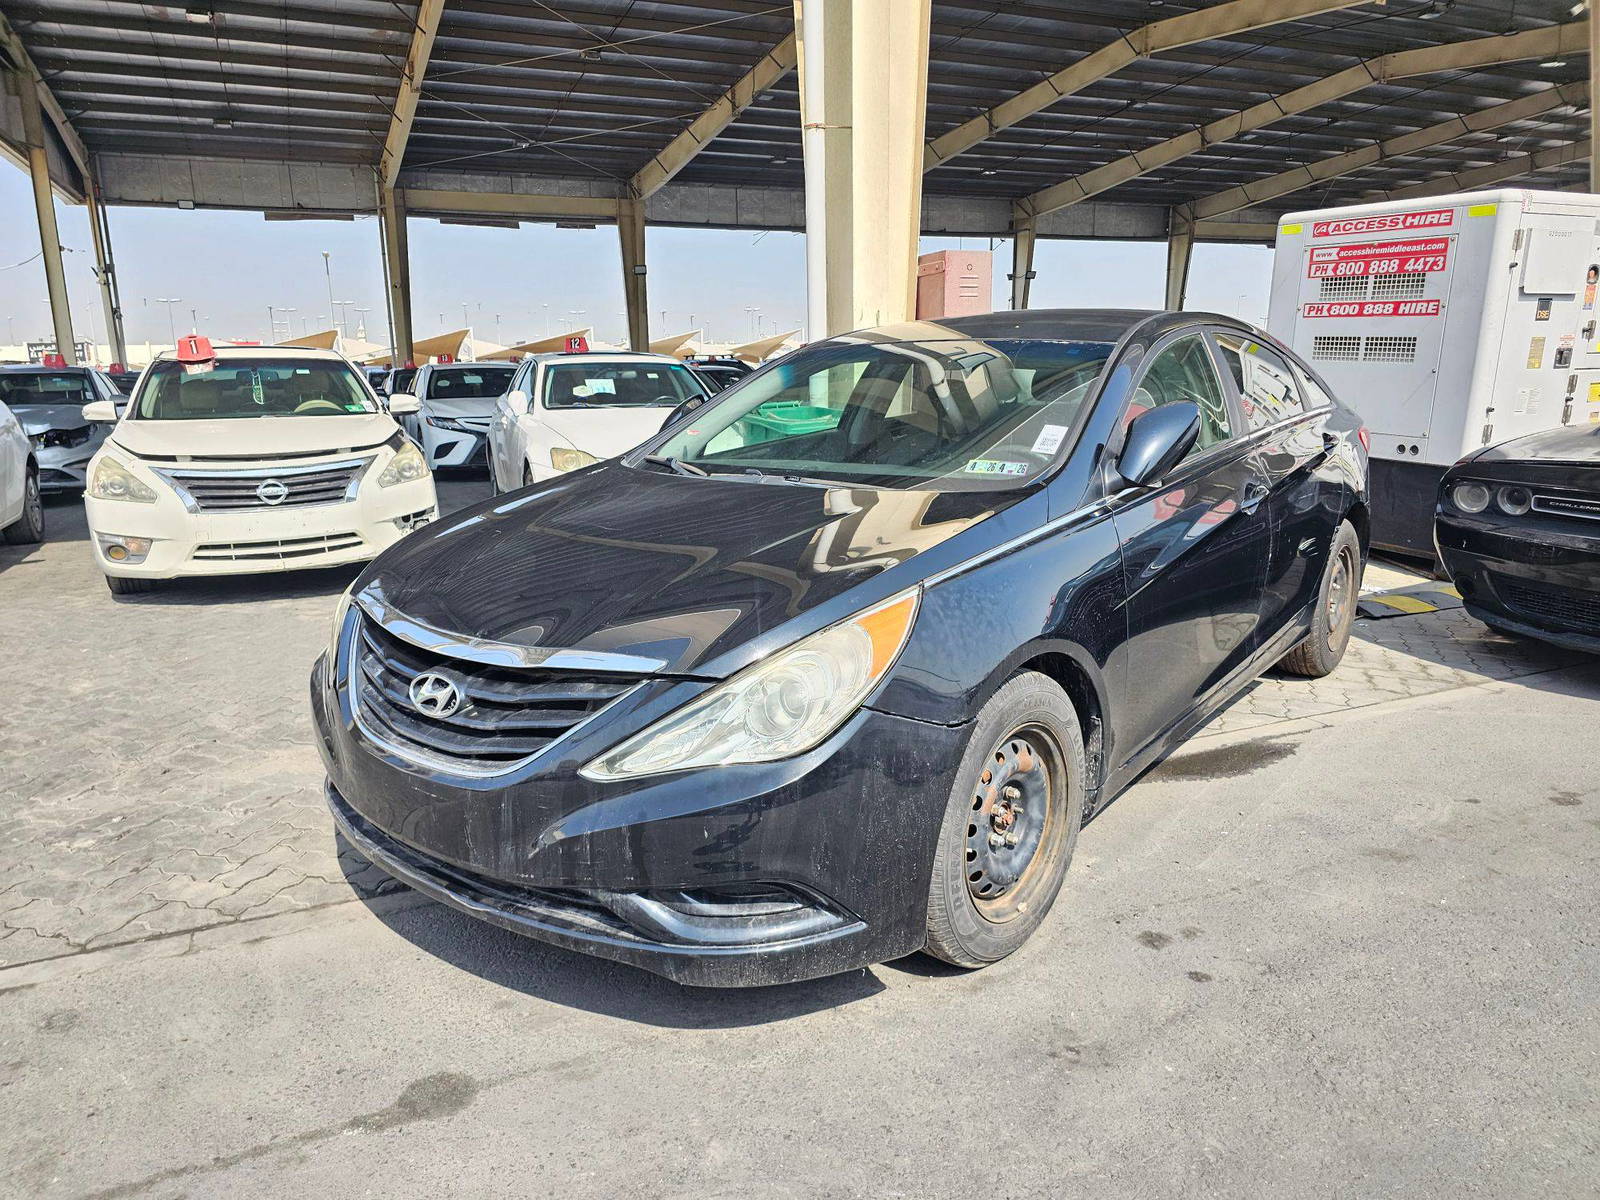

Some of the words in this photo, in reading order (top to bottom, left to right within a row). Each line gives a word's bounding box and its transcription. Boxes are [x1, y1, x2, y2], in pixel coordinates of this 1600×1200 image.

[1331, 217, 1400, 233] ACCESS
[1405, 212, 1453, 226] HIRE
[1313, 264, 1329, 275] PH
[1336, 261, 1365, 275] 800
[1368, 259, 1400, 274] 888
[1404, 256, 1445, 271] 4473
[1307, 305, 1325, 315] PH
[1329, 304, 1360, 315] 800
[1362, 303, 1395, 315] 888
[1398, 301, 1439, 314] HIRE
[190, 339, 198, 354] 1
[571, 337, 580, 349] 12
